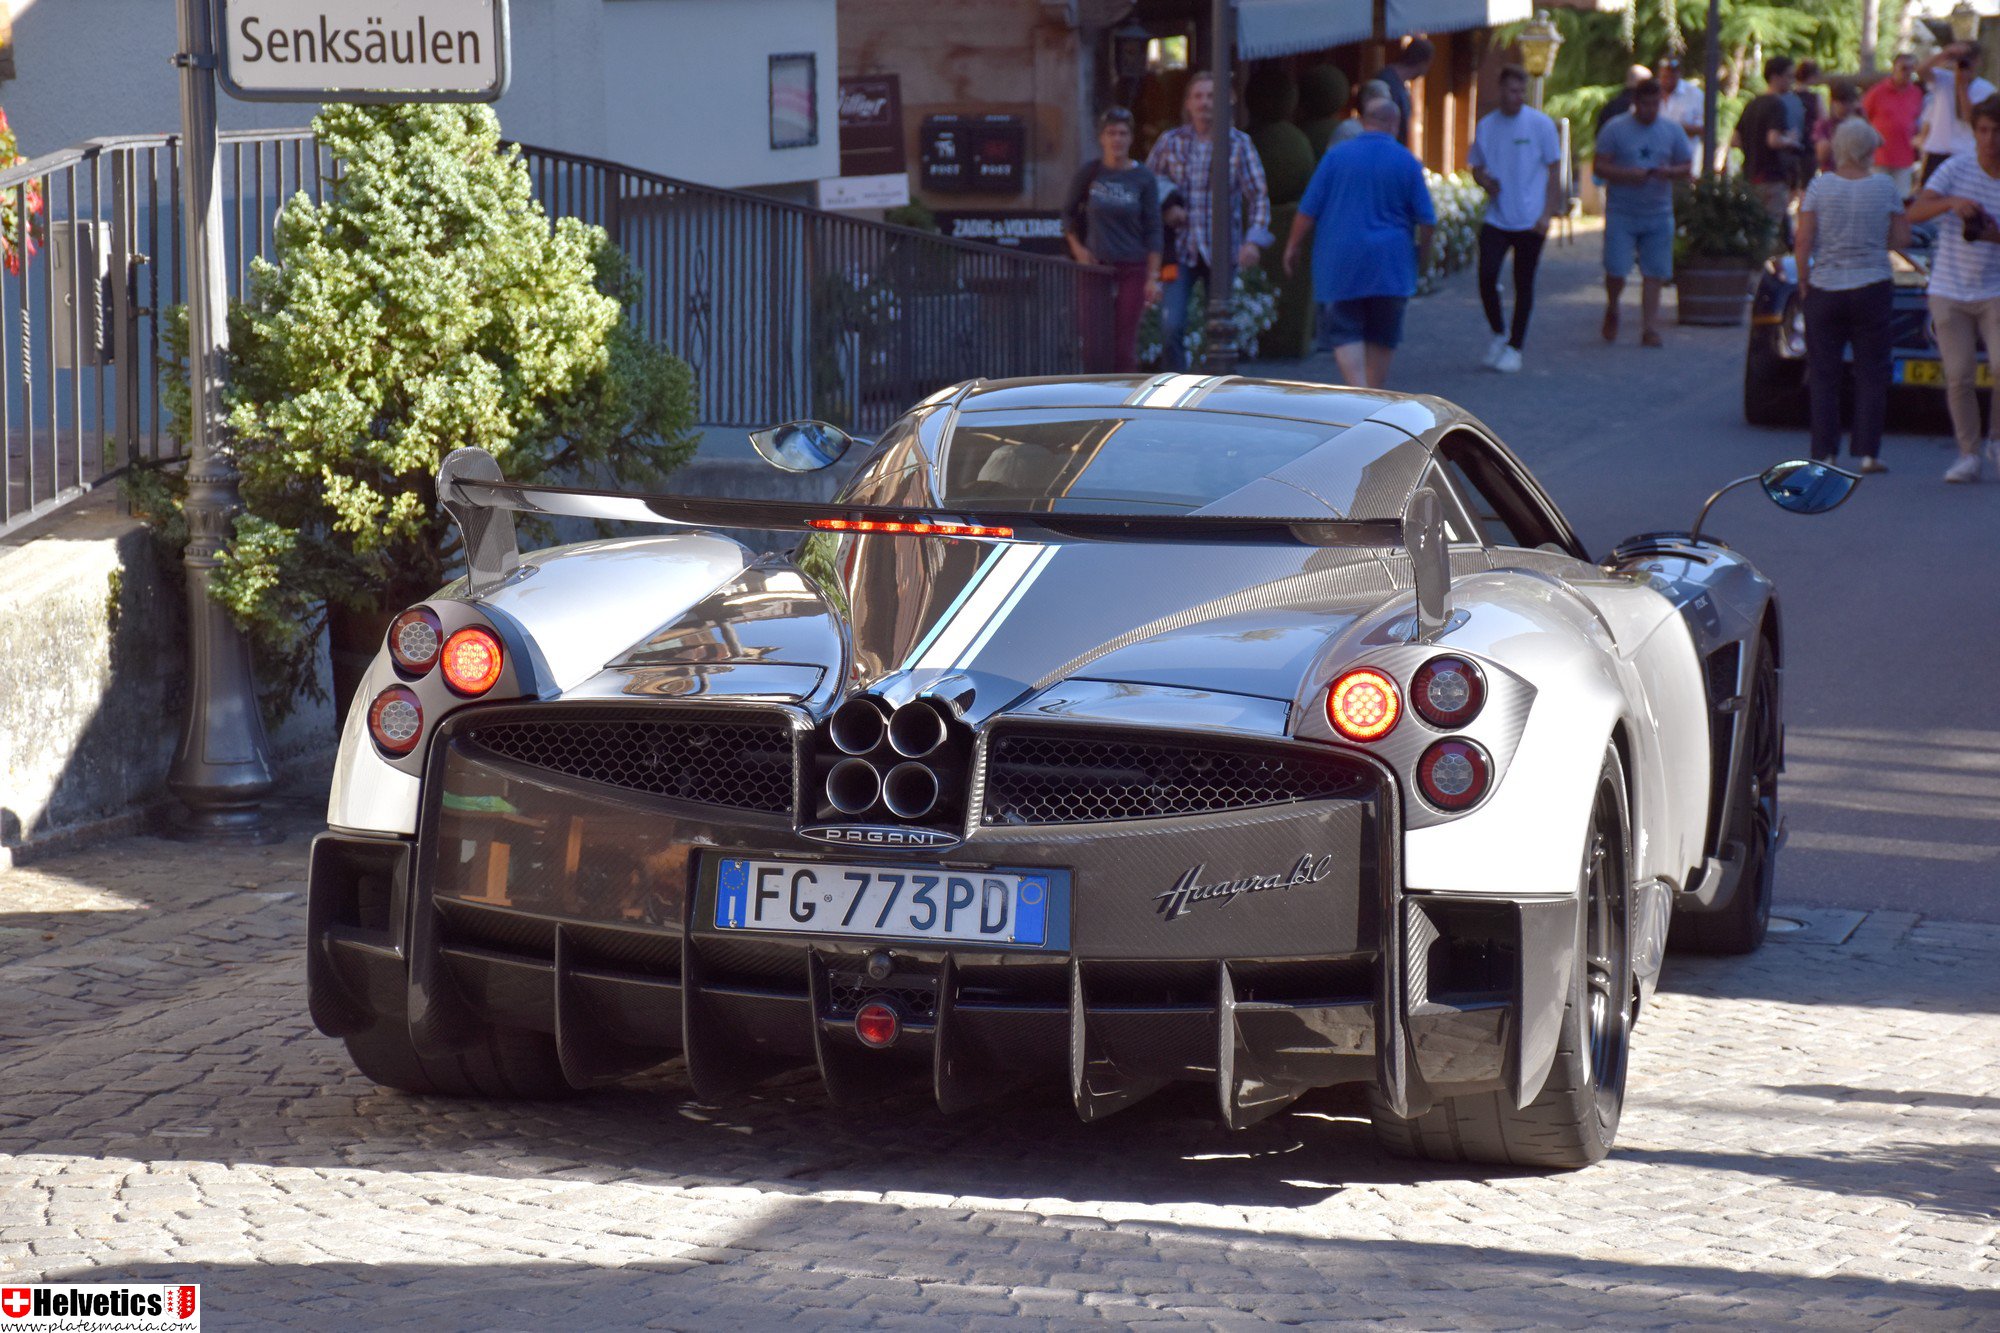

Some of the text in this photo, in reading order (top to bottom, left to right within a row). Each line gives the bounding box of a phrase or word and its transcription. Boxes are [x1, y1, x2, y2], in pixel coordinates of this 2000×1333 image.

[240, 14, 481, 65] Senksäulen
[826, 829, 935, 845] PAGANI
[1152, 863, 1284, 916] Huayra
